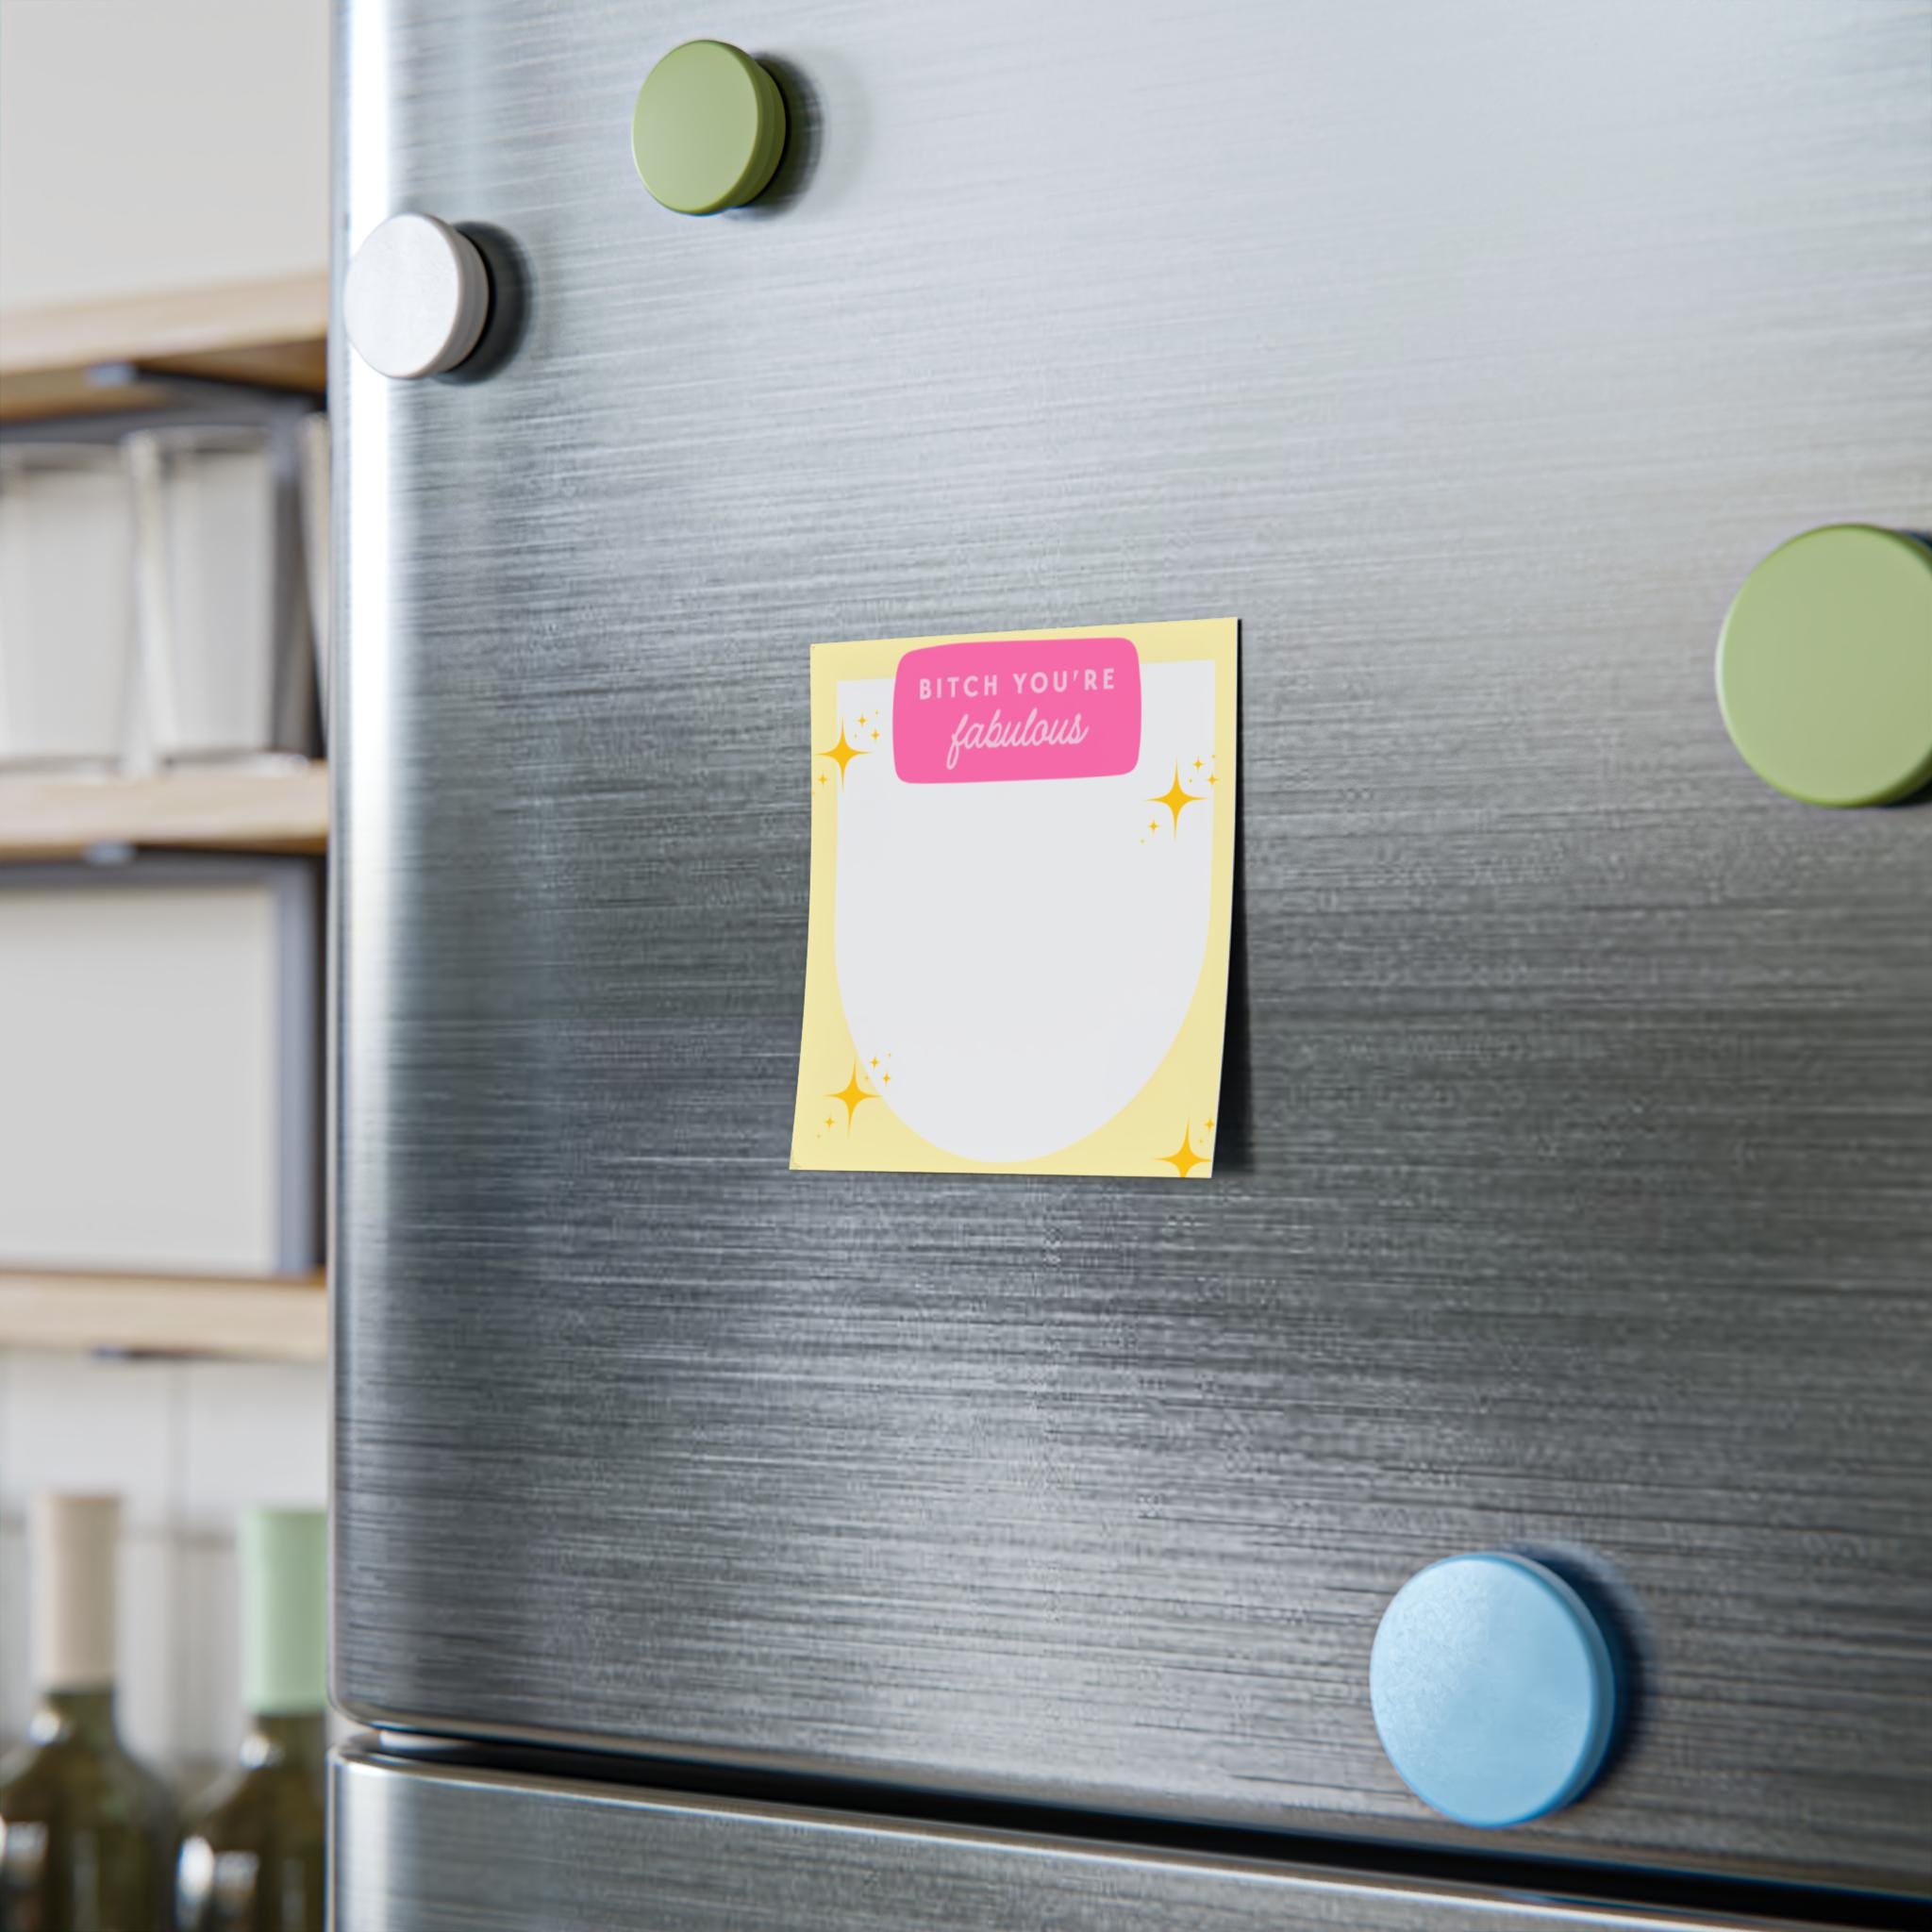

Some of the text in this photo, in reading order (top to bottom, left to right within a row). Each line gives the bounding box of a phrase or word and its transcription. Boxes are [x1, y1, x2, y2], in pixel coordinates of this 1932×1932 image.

[919, 668, 1115, 700] BITCH YOU'RE
[946, 708, 1089, 770] fabulous
